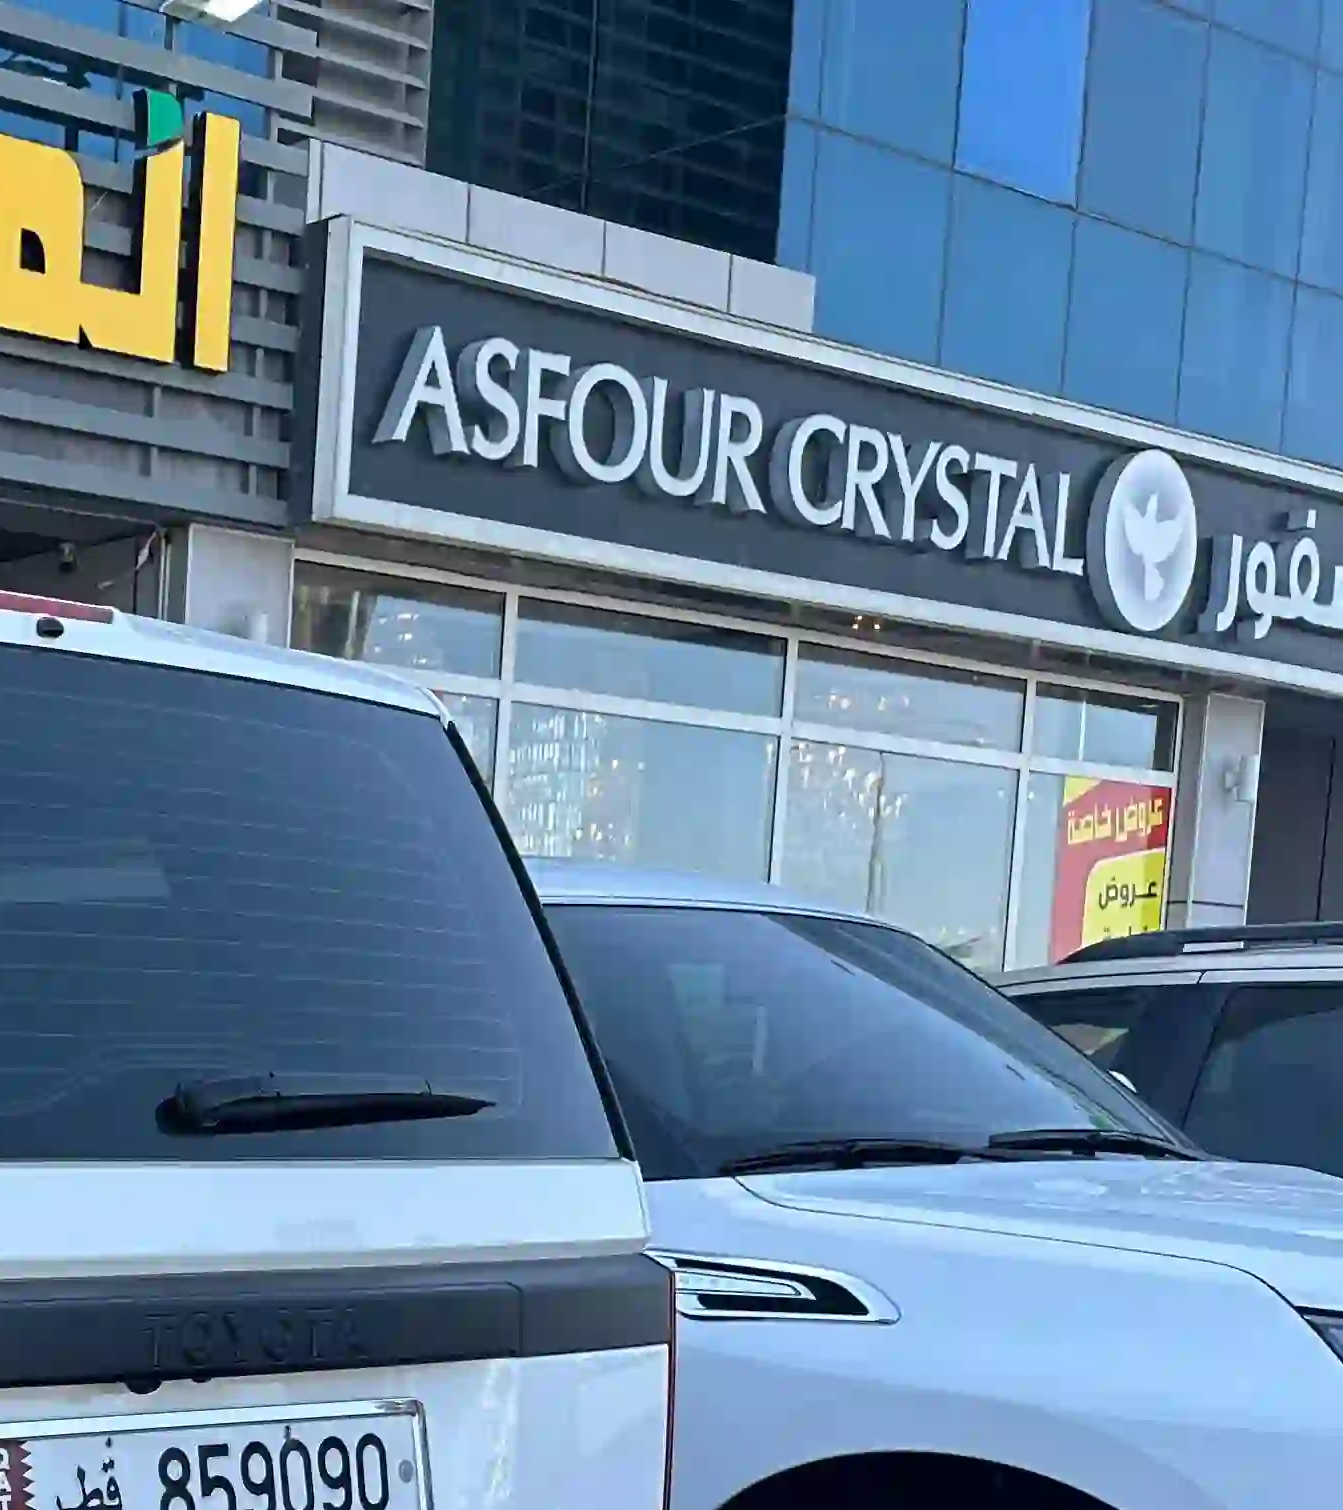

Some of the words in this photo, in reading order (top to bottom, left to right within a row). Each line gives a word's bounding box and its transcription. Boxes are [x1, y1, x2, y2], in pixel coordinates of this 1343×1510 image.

[381, 325, 768, 514] ASFOUR
[785, 413, 1084, 576] CRYSTAL
[141, 1305, 369, 1369] TOYOTA
